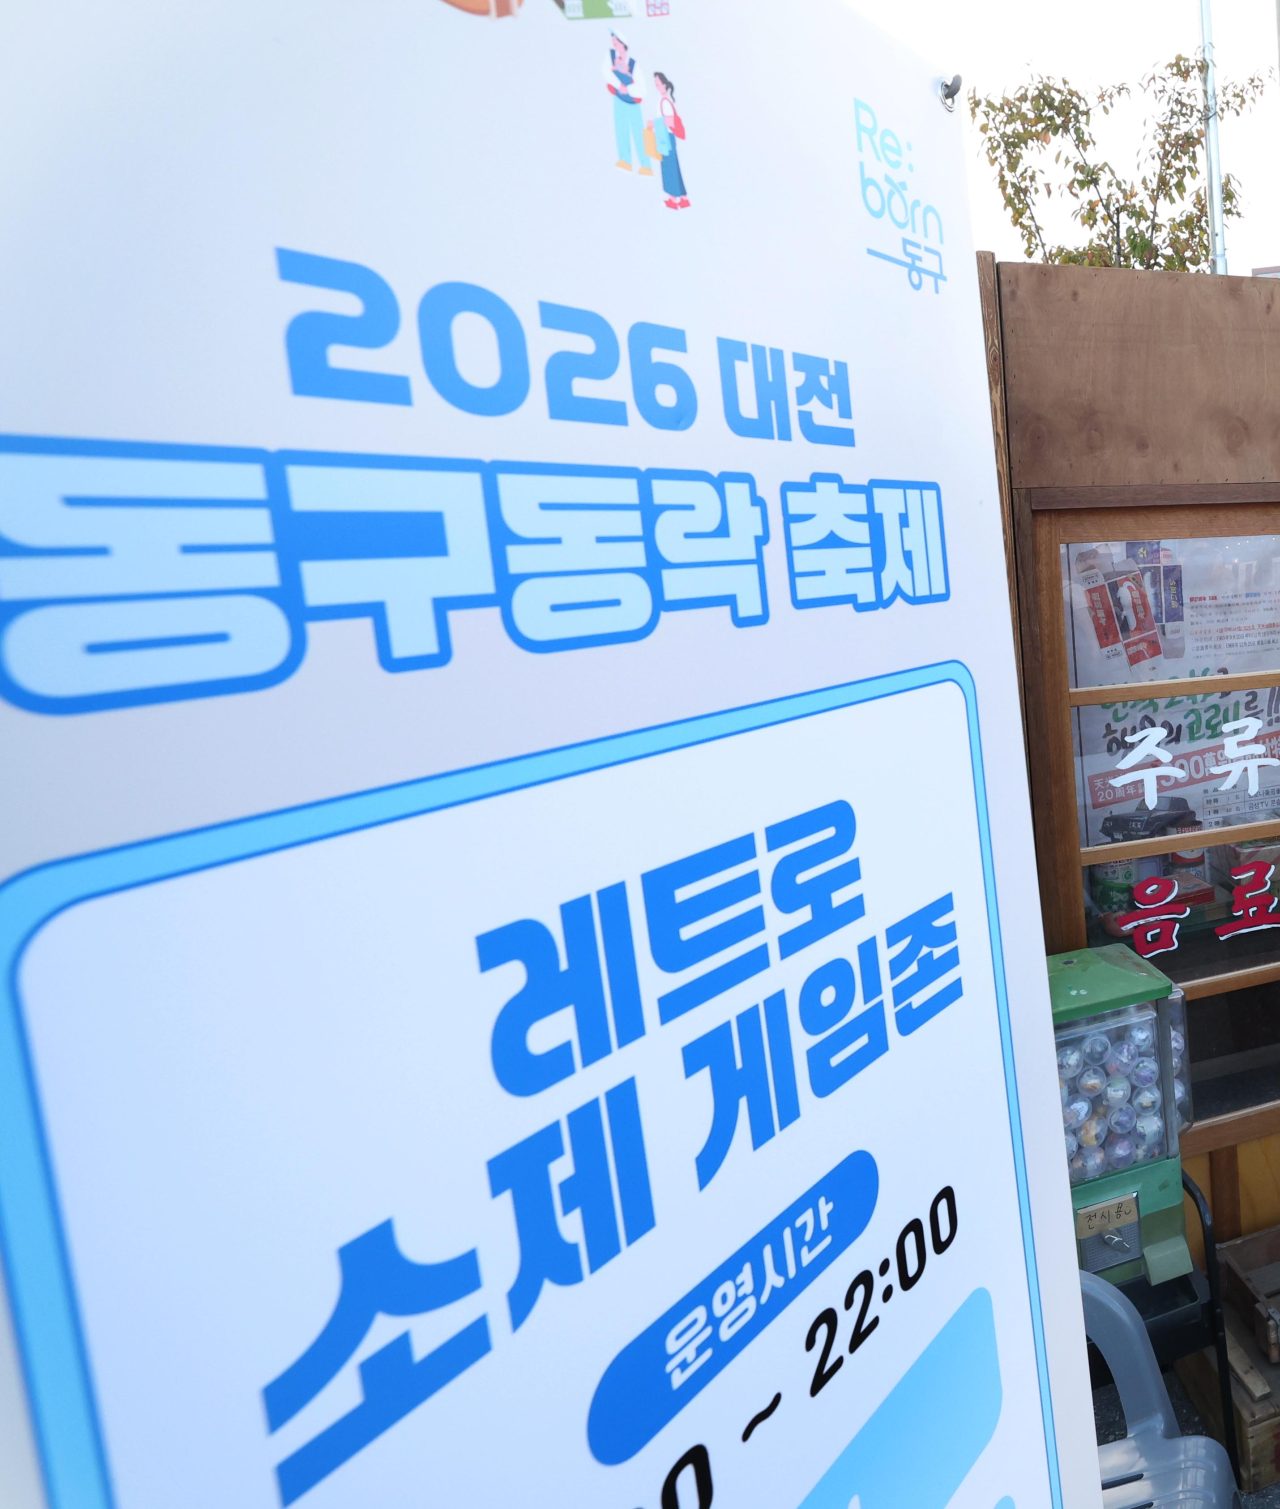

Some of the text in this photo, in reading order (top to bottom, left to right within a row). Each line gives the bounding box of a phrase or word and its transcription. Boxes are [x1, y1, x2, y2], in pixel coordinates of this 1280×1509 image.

[275, 247, 856, 448] 2026 대전
[0, 434, 951, 716] 동구동락 축제
[1109, 717, 1280, 810] 주류
[474, 799, 866, 1097] 레트로
[262, 891, 964, 1509] 소제 게임존
[664, 1194, 834, 1391] 운영시간
[805, 1185, 960, 1398] 22:00
